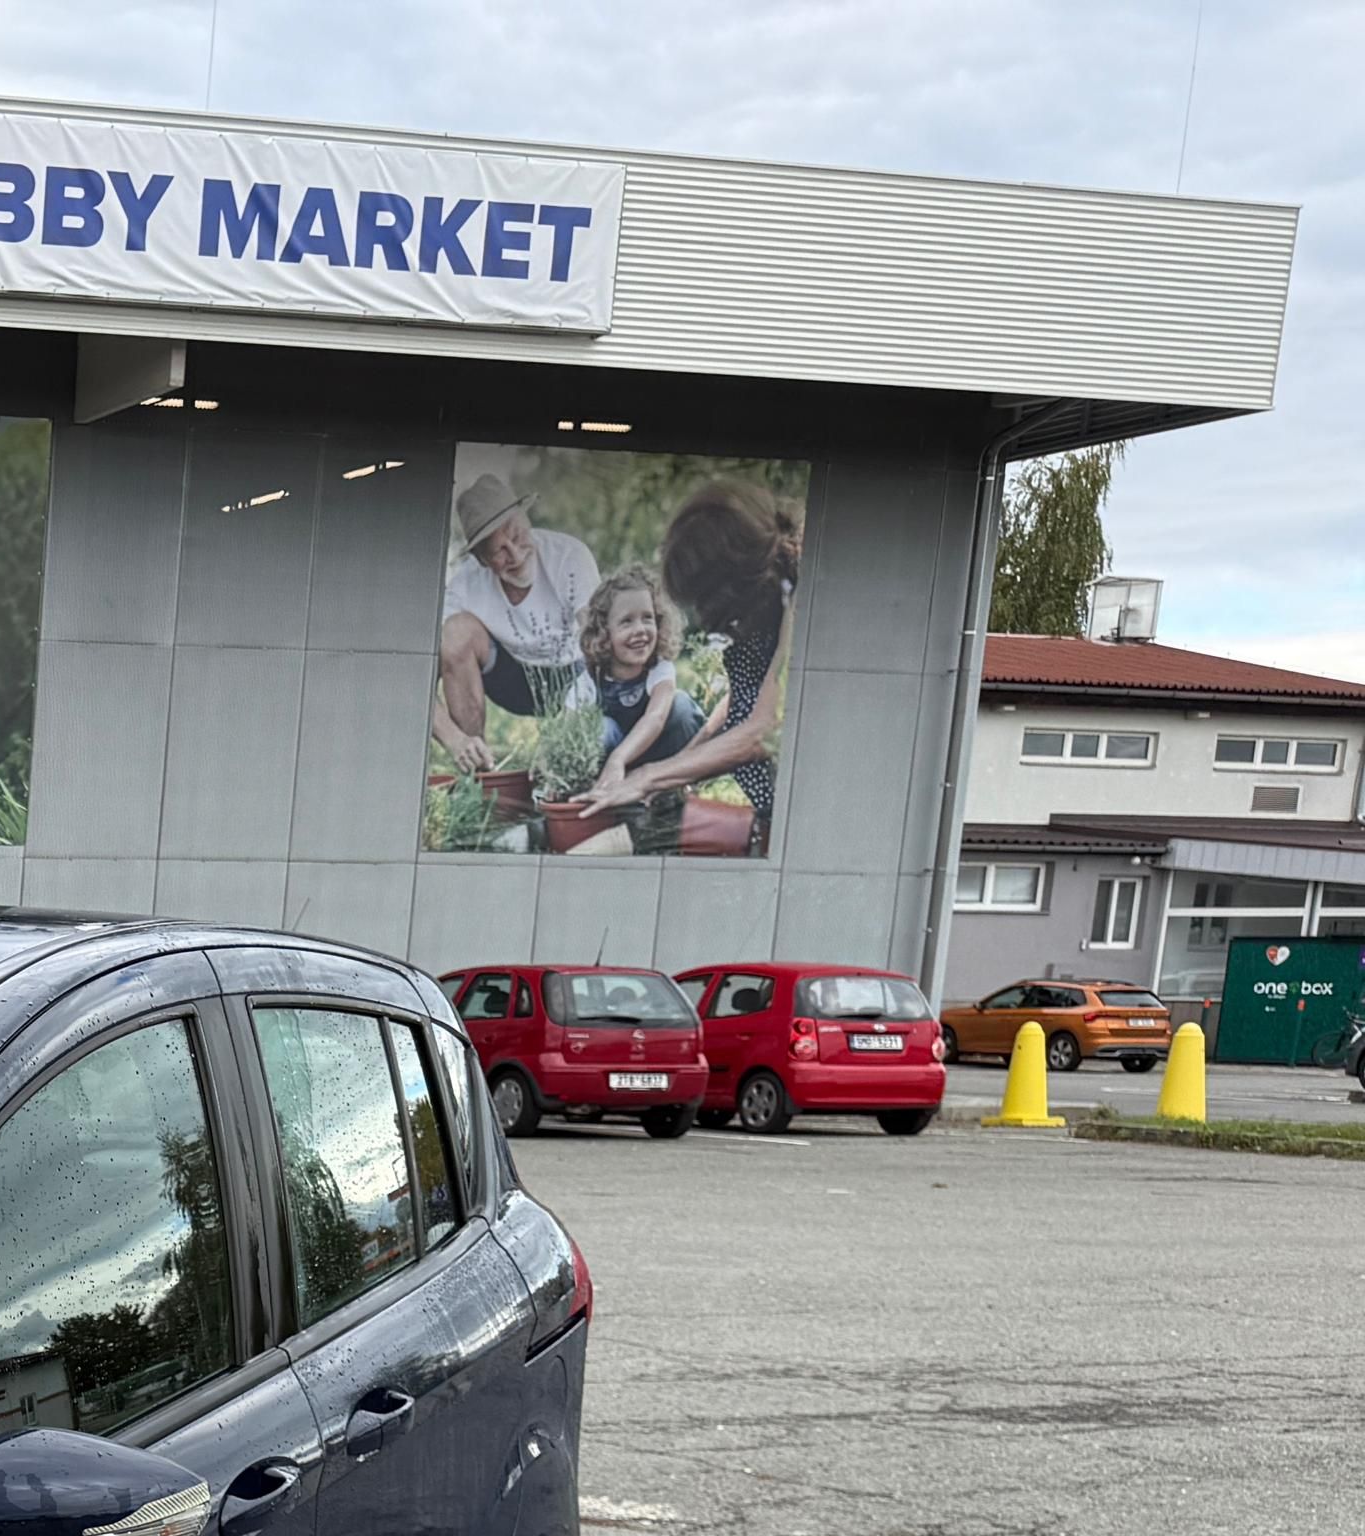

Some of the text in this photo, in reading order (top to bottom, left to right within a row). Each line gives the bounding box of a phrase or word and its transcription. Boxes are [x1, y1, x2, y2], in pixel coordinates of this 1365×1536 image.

[198, 178, 593, 283] MARKET
[1253, 981, 1333, 995] one box
